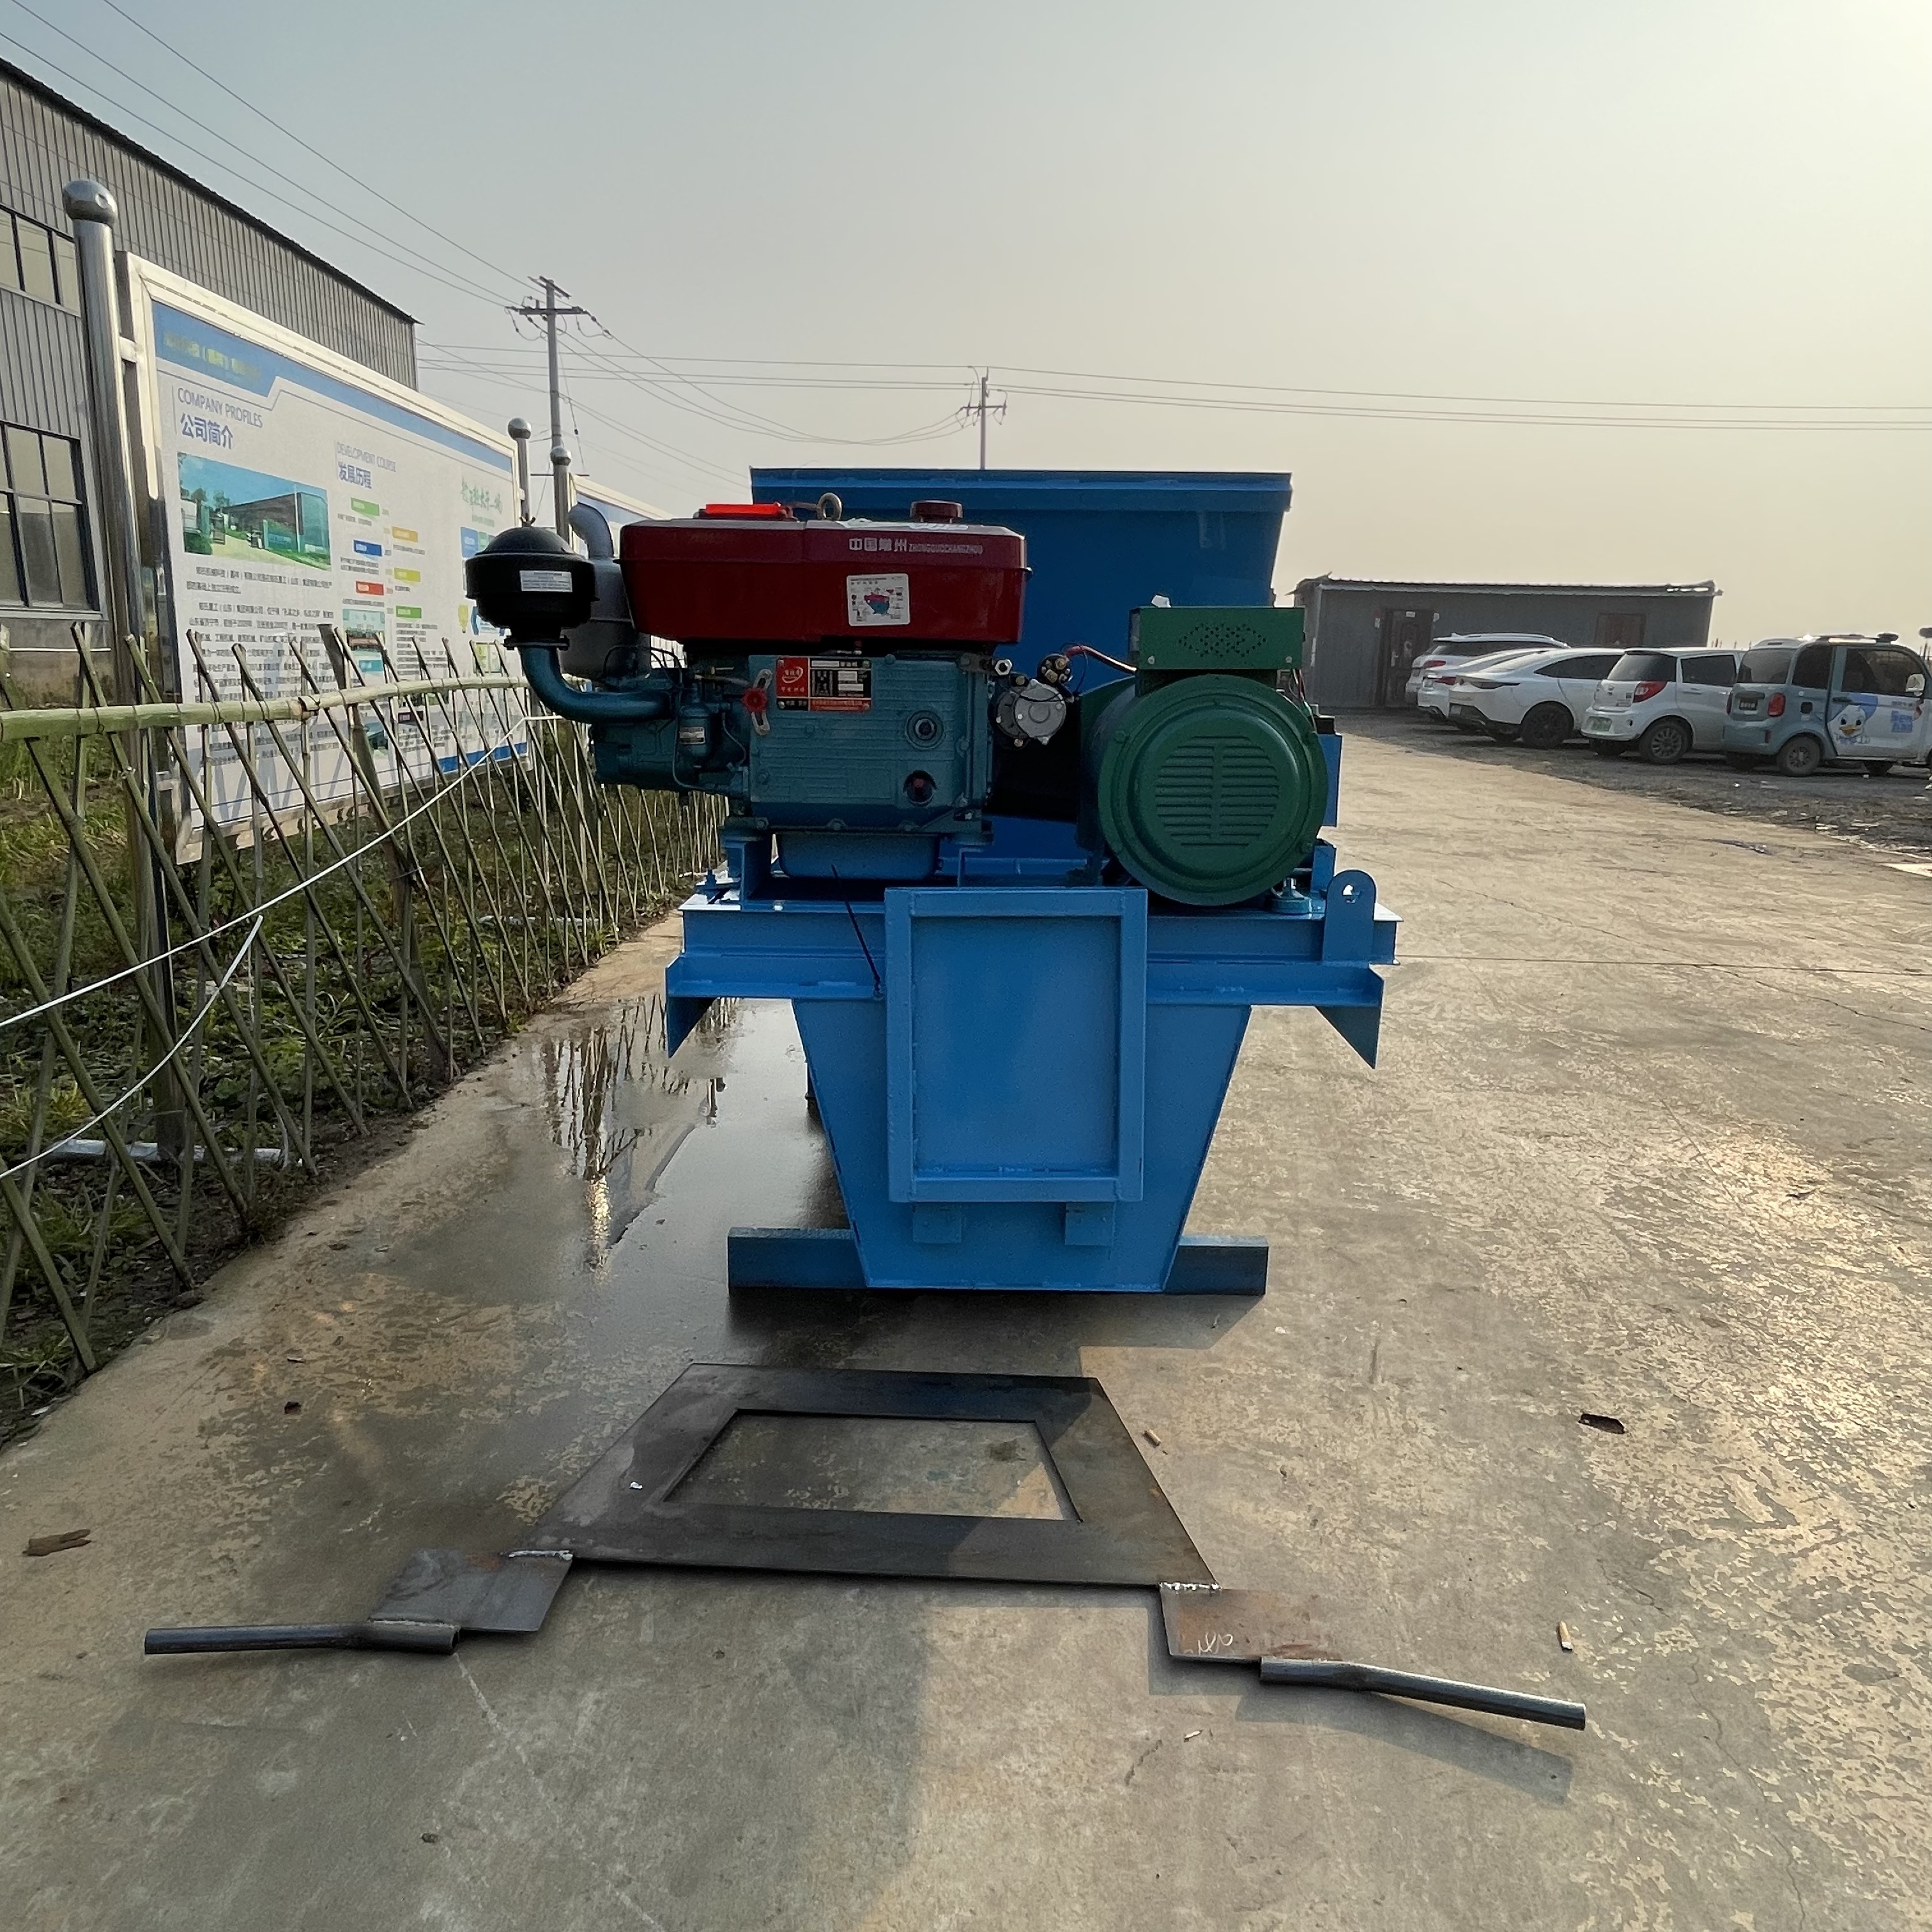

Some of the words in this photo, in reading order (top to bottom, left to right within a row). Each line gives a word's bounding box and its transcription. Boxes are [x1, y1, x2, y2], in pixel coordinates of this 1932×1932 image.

[178, 387, 223, 415] COMPANY
[225, 403, 263, 428] PROFILES
[180, 413, 233, 449] 公司简介
